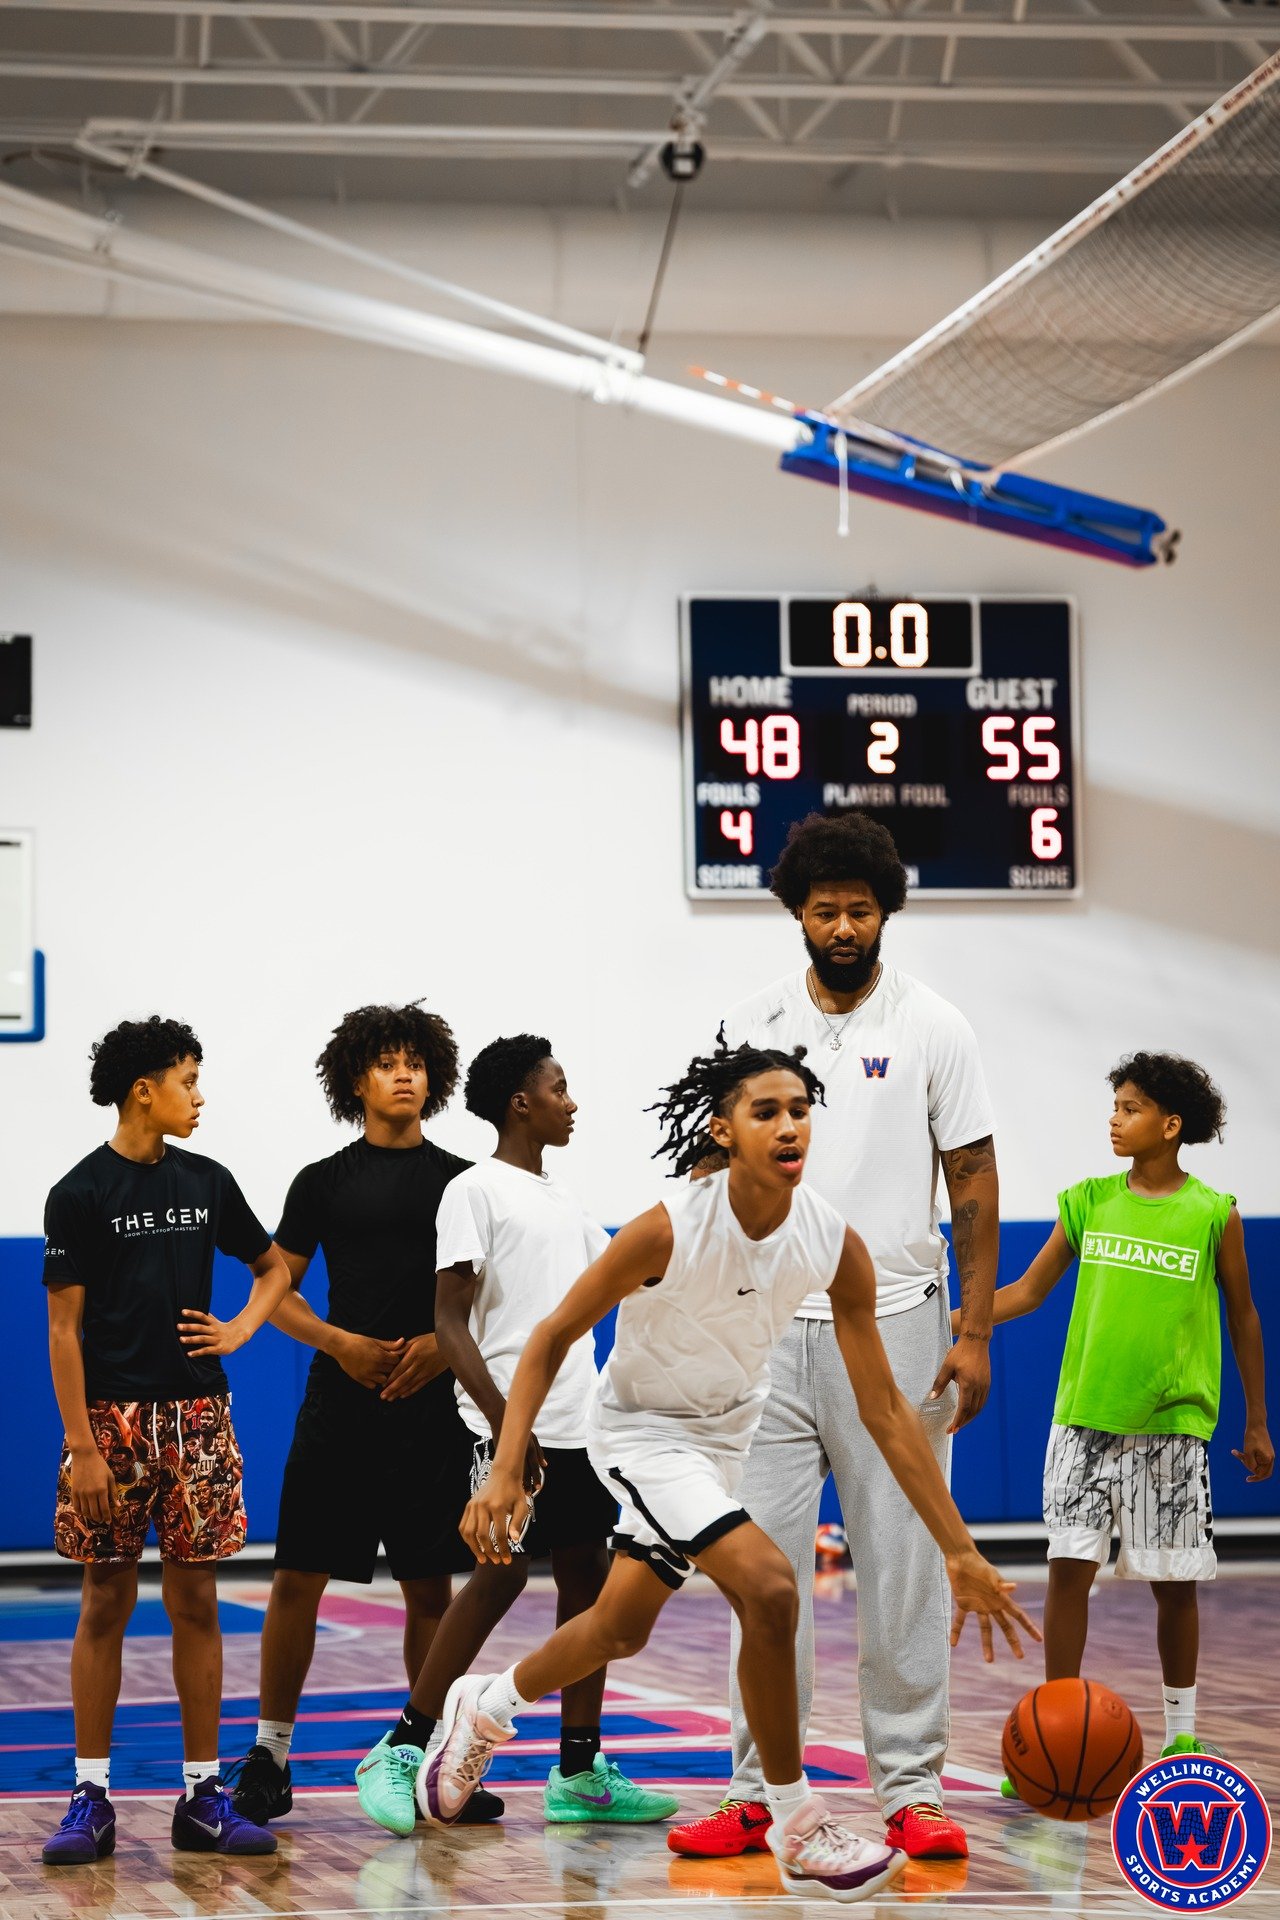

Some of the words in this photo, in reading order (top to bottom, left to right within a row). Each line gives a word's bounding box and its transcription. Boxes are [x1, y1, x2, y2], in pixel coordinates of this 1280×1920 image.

[833, 602, 928, 668] 0.0
[709, 676, 793, 709] HOME
[847, 694, 917, 717] PERIOD
[966, 677, 1057, 710] GUEST
[720, 714, 800, 780] 48
[866, 721, 900, 774] 2
[981, 715, 1060, 780] 55
[697, 782, 761, 806] FOULS
[823, 783, 896, 806] PLAYER
[900, 783, 949, 807] FOUL
[1008, 783, 1069, 806] FOULS
[720, 810, 753, 856] 4
[1030, 807, 1063, 859] 6
[698, 864, 762, 888] SCORE
[1009, 865, 1070, 888] SCORE
[859, 1056, 892, 1079] W
[111, 1212, 154, 1233] THE
[166, 1208, 208, 1224] GEM
[1094, 1239, 1194, 1273] ALLIANCE
